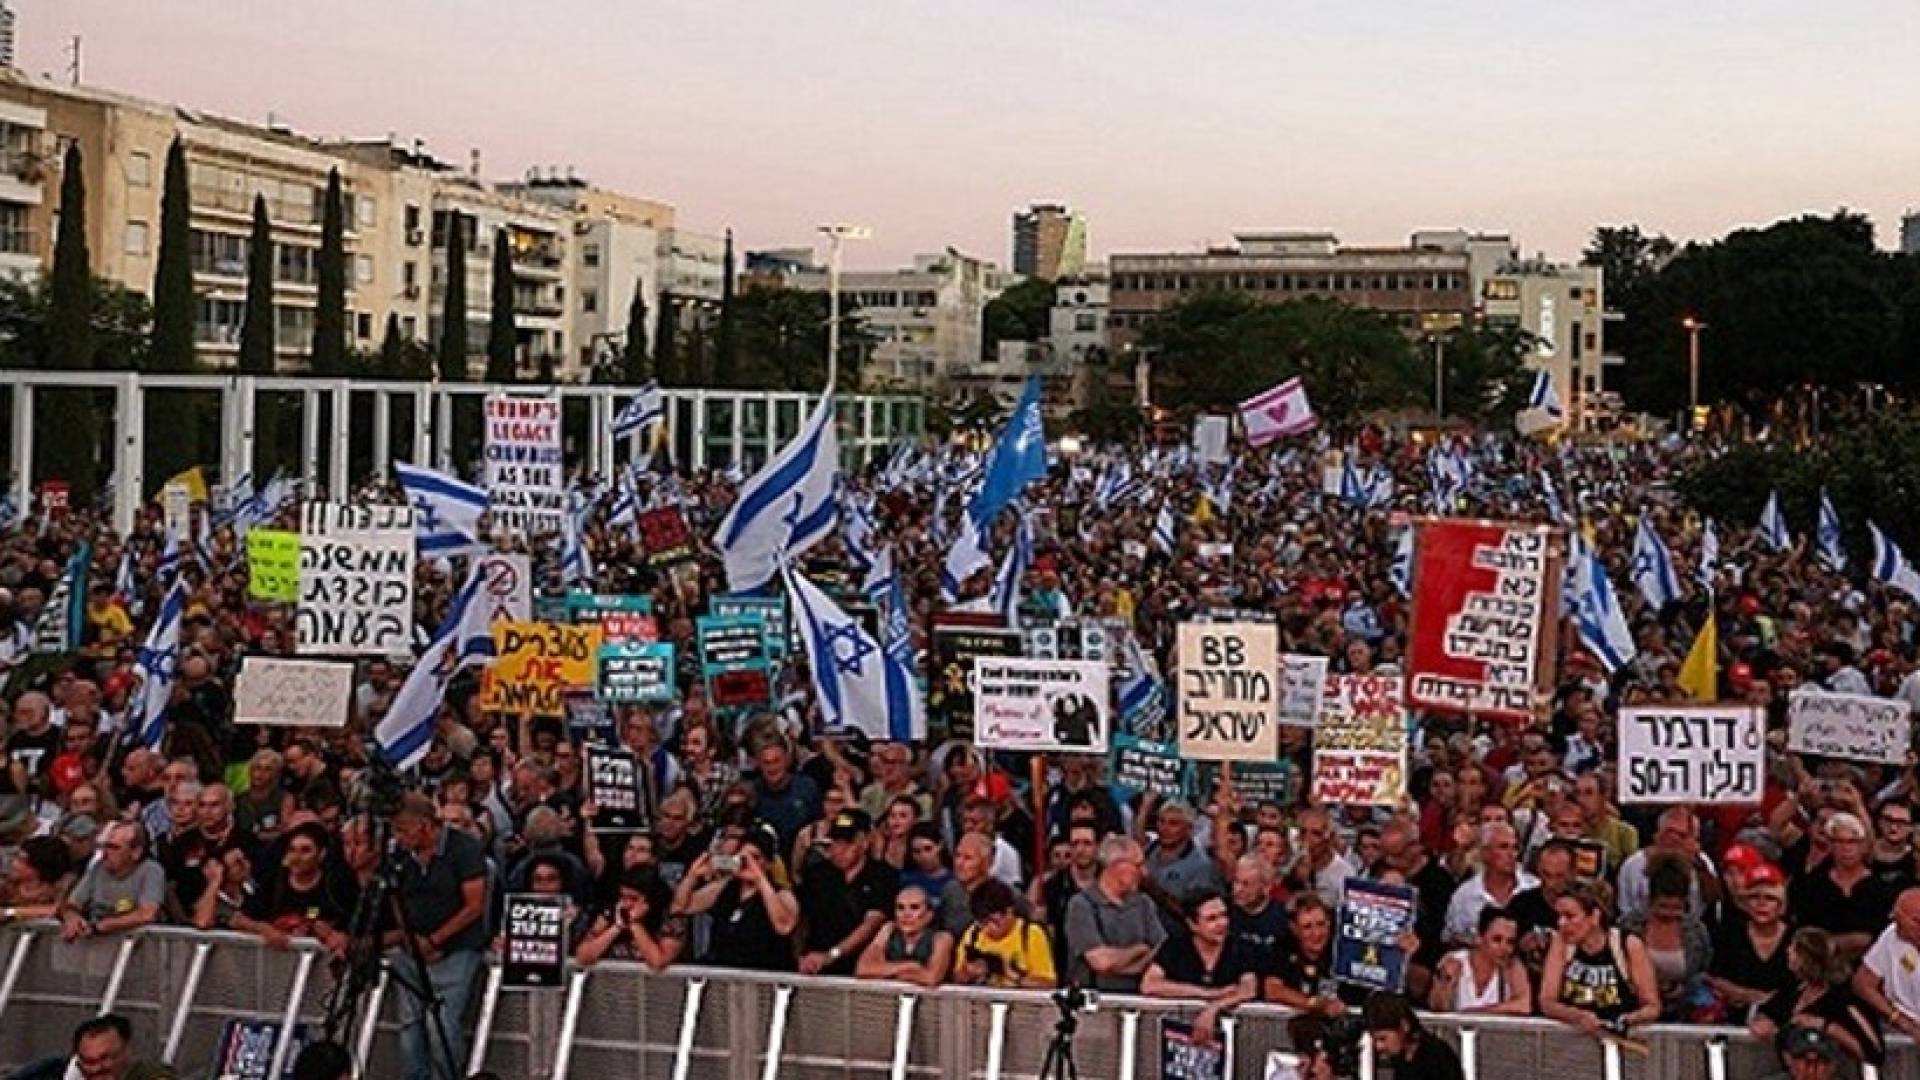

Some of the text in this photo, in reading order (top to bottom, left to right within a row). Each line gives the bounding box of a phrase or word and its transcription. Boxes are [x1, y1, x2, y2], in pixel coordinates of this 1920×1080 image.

[487, 401, 558, 420] TRUMP'S
[492, 422, 552, 441] LEGACY
[498, 466, 551, 486] AS THE
[299, 543, 407, 574] ממשלה
[303, 575, 409, 608] בוגדת
[296, 606, 405, 648] בעמה
[1201, 635, 1245, 666] BB
[515, 657, 564, 681] את
[1184, 669, 1271, 703] מחריב
[1323, 675, 1399, 699] STOP
[1184, 700, 1266, 744] ישראל
[1634, 715, 1738, 749] דרמר
